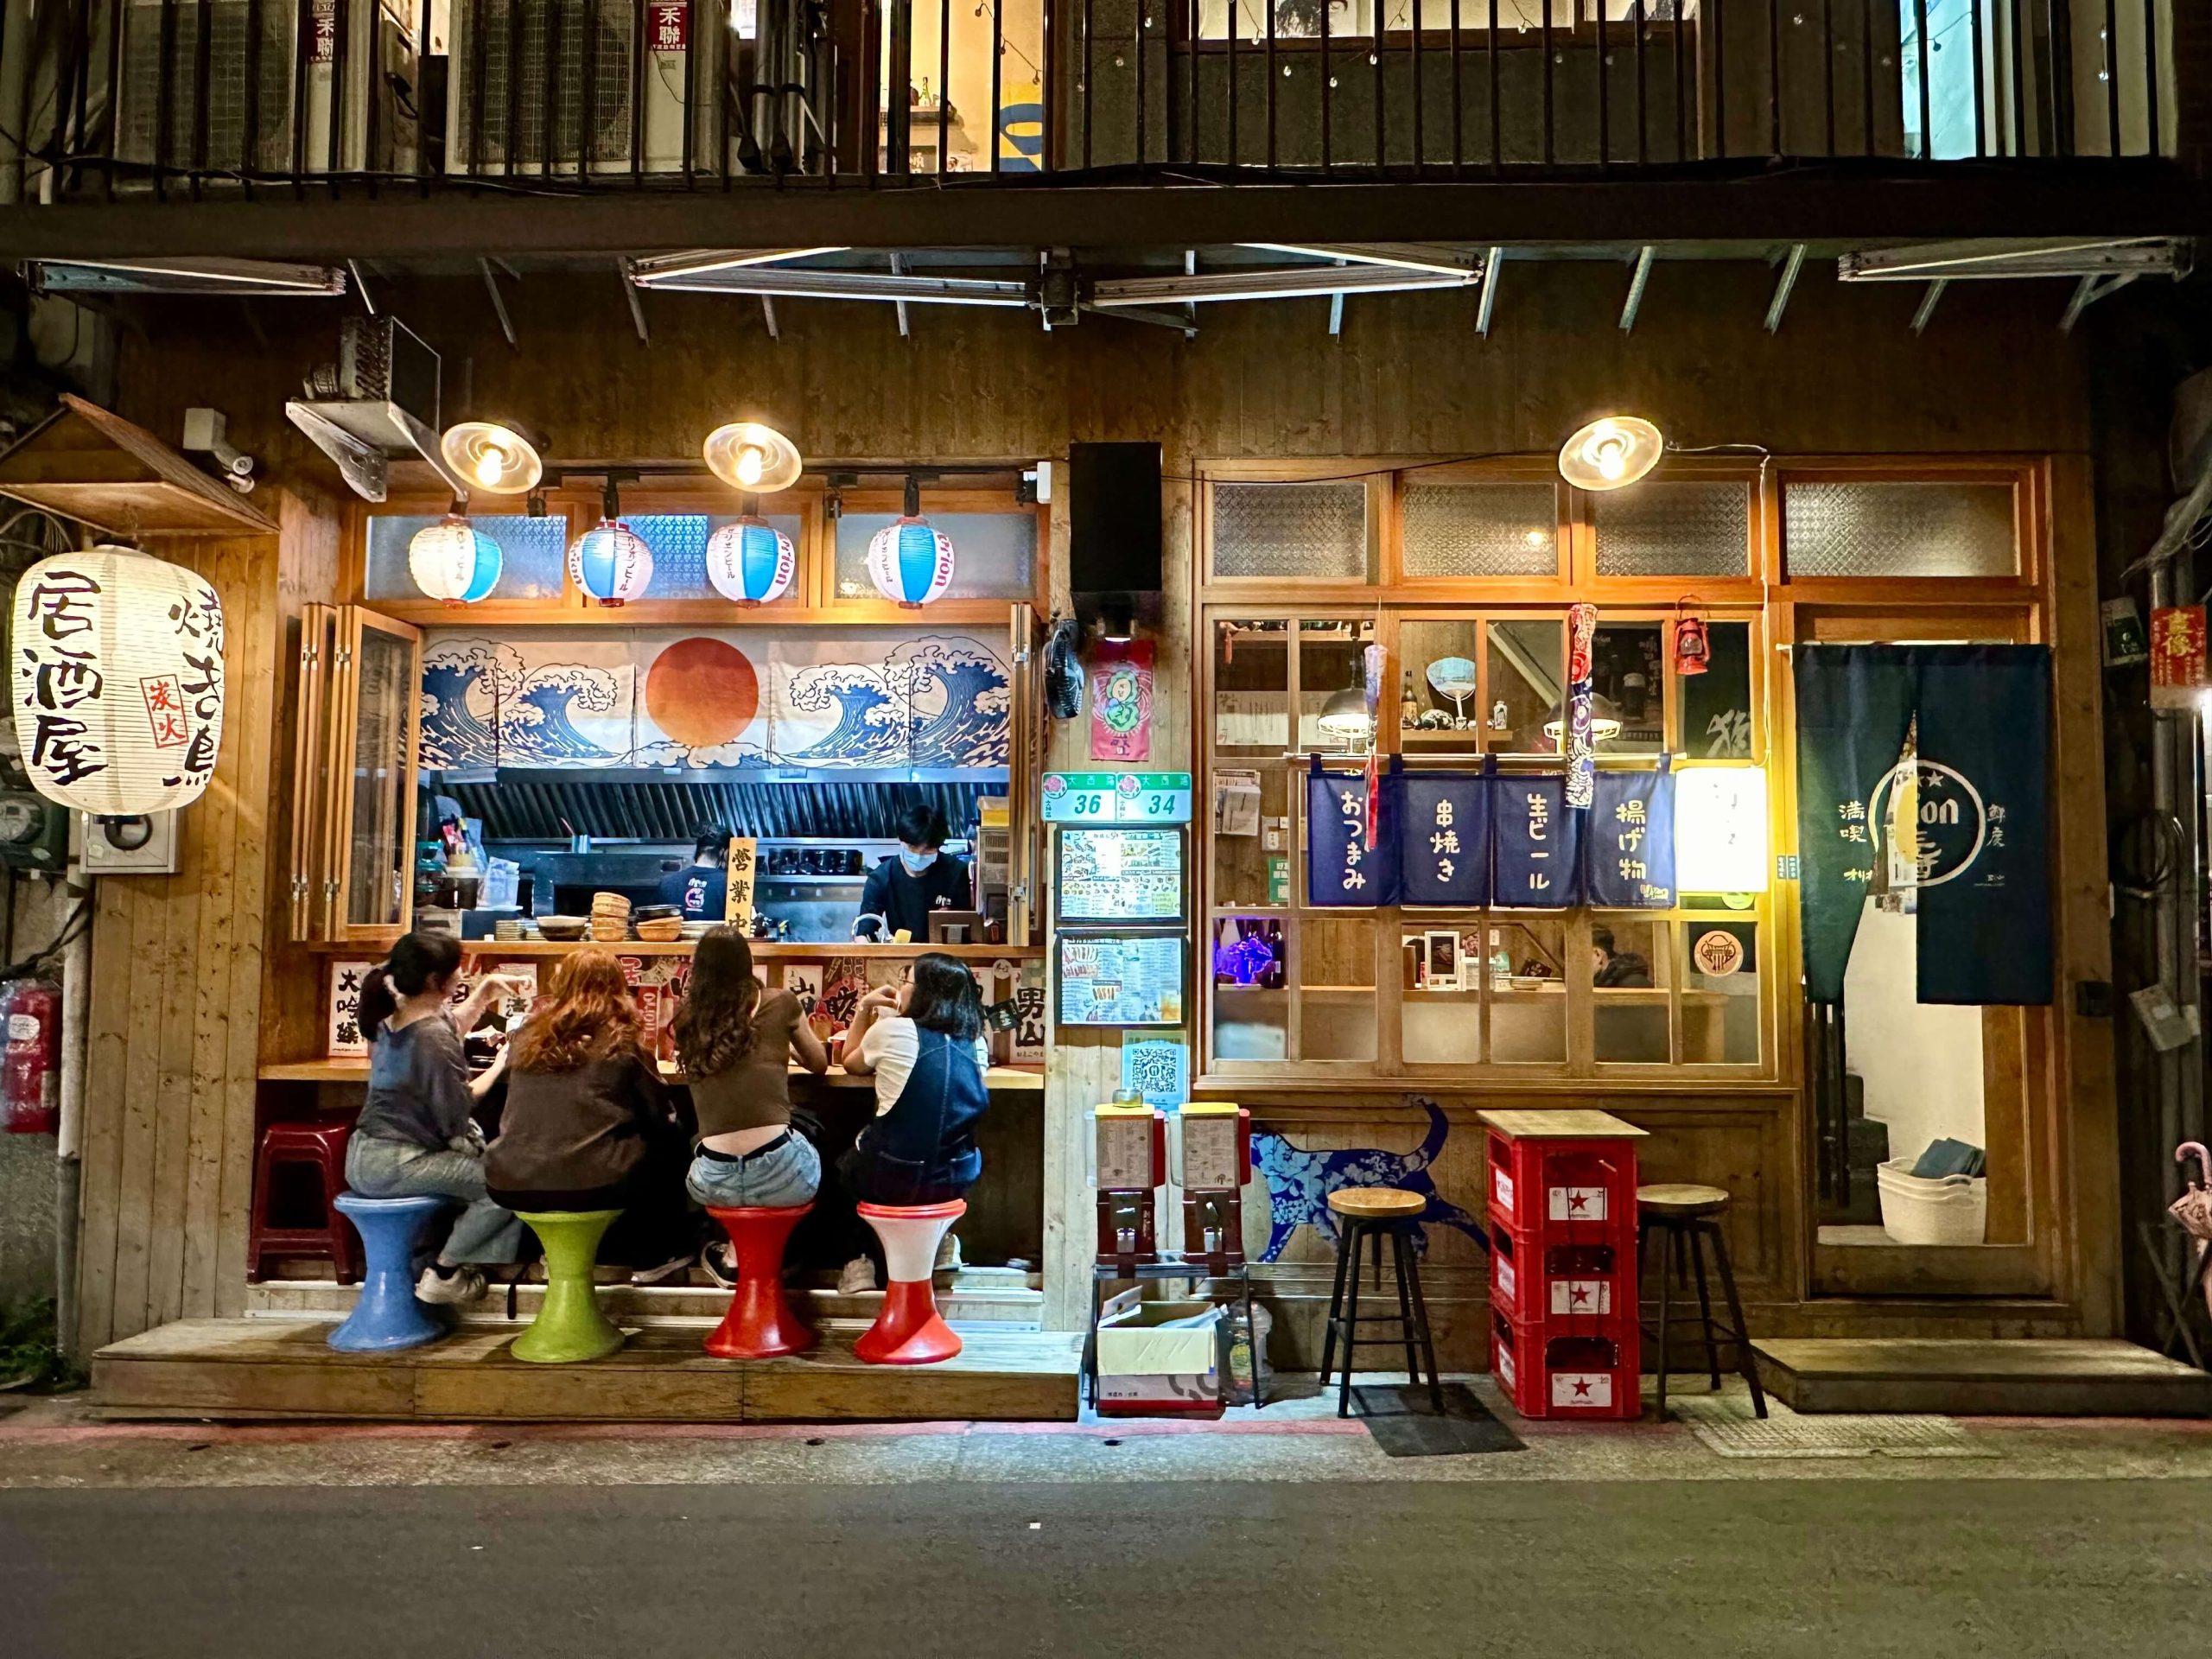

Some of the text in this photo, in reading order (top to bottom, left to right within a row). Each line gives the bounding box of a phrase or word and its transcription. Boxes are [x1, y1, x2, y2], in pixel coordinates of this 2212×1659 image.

[22, 571, 109, 785] 居酒屋
[1074, 795, 1102, 814] 36
[1148, 795, 1175, 815] 34
[1839, 800, 1866, 842] 満喫
[1917, 798, 1959, 824] on
[1341, 791, 1366, 889] おつまみ
[1430, 799, 1460, 881] 串焼き
[1528, 793, 1550, 889] 生ビール
[1616, 800, 1647, 880] 揚げ物
[1016, 988, 1046, 1047] 男山
